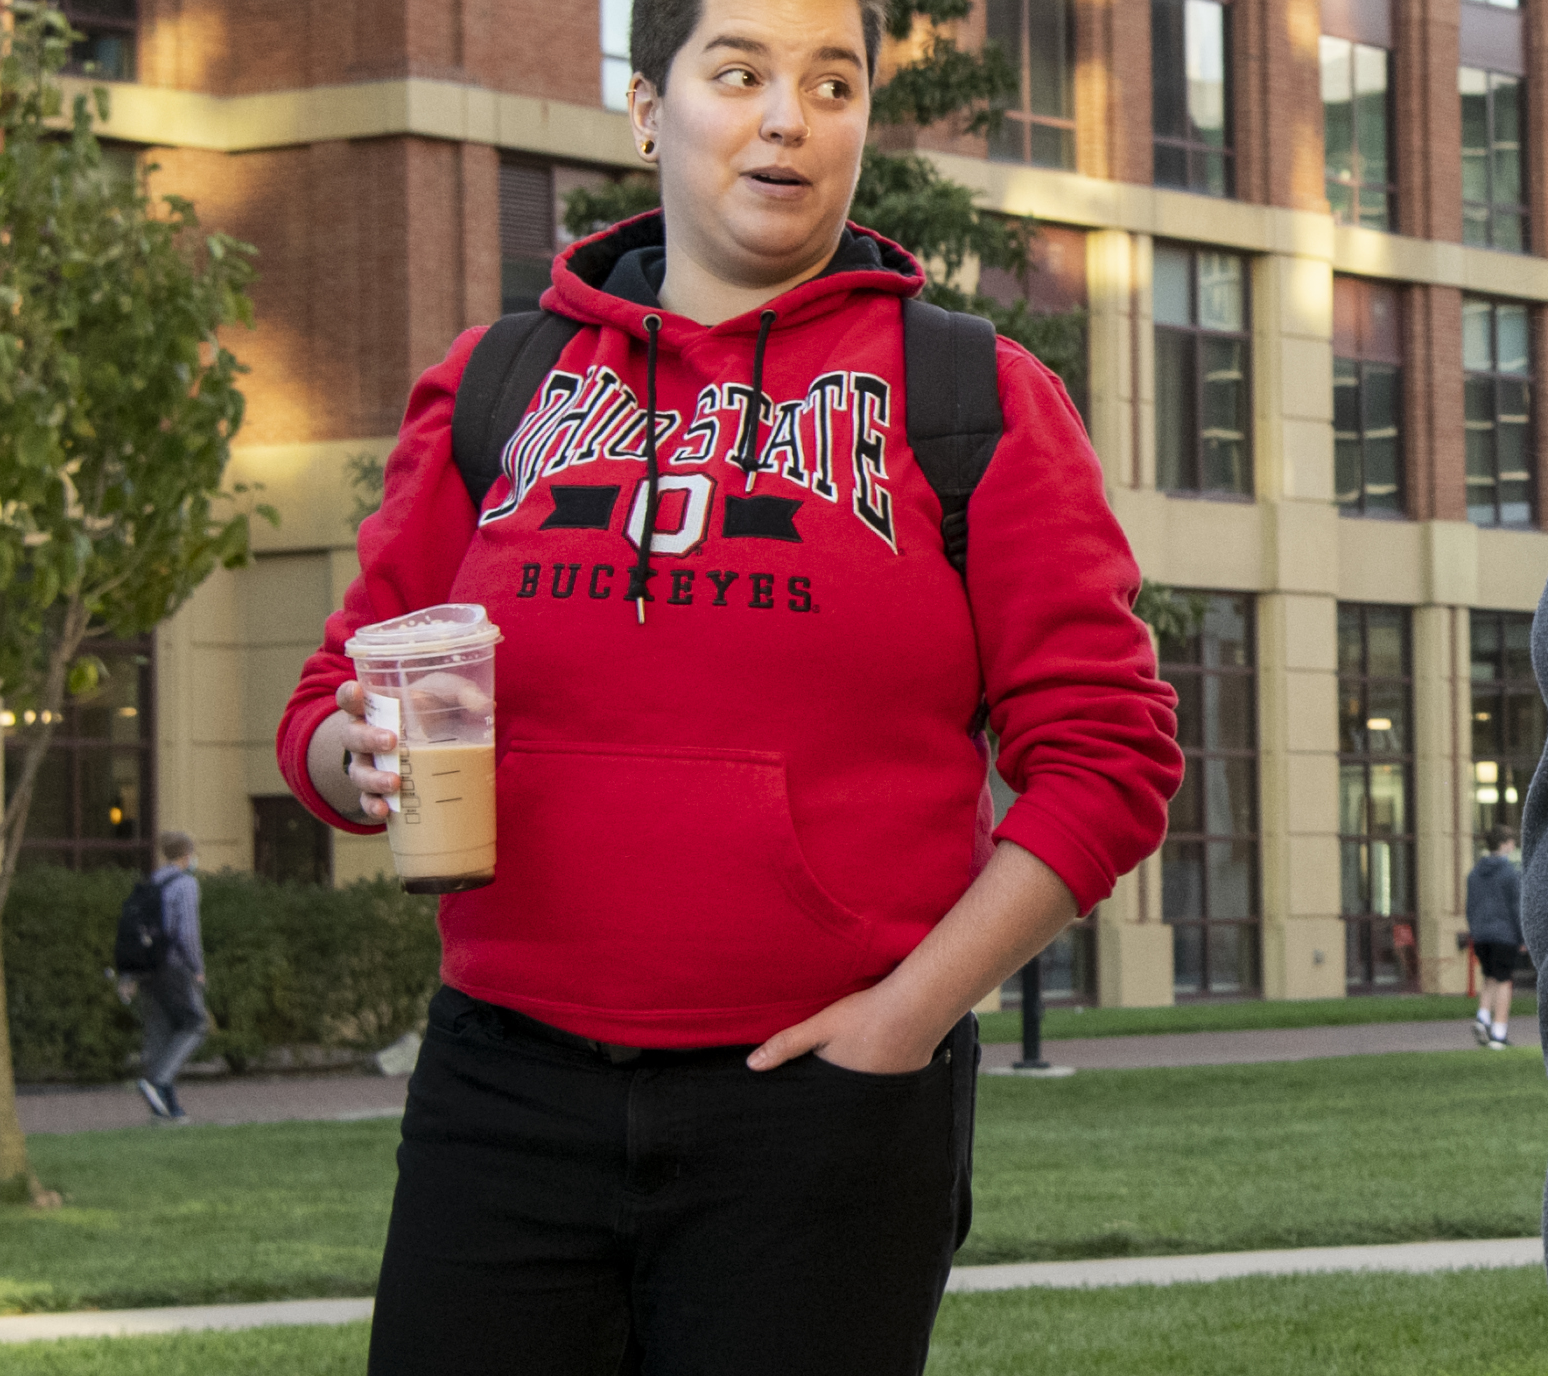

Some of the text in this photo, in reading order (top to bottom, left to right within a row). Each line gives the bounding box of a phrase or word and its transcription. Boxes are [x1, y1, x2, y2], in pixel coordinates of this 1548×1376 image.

[478, 365, 898, 555] OHIO STATE
[623, 472, 717, 557] O
[516, 562, 812, 612] BUCKEYES
